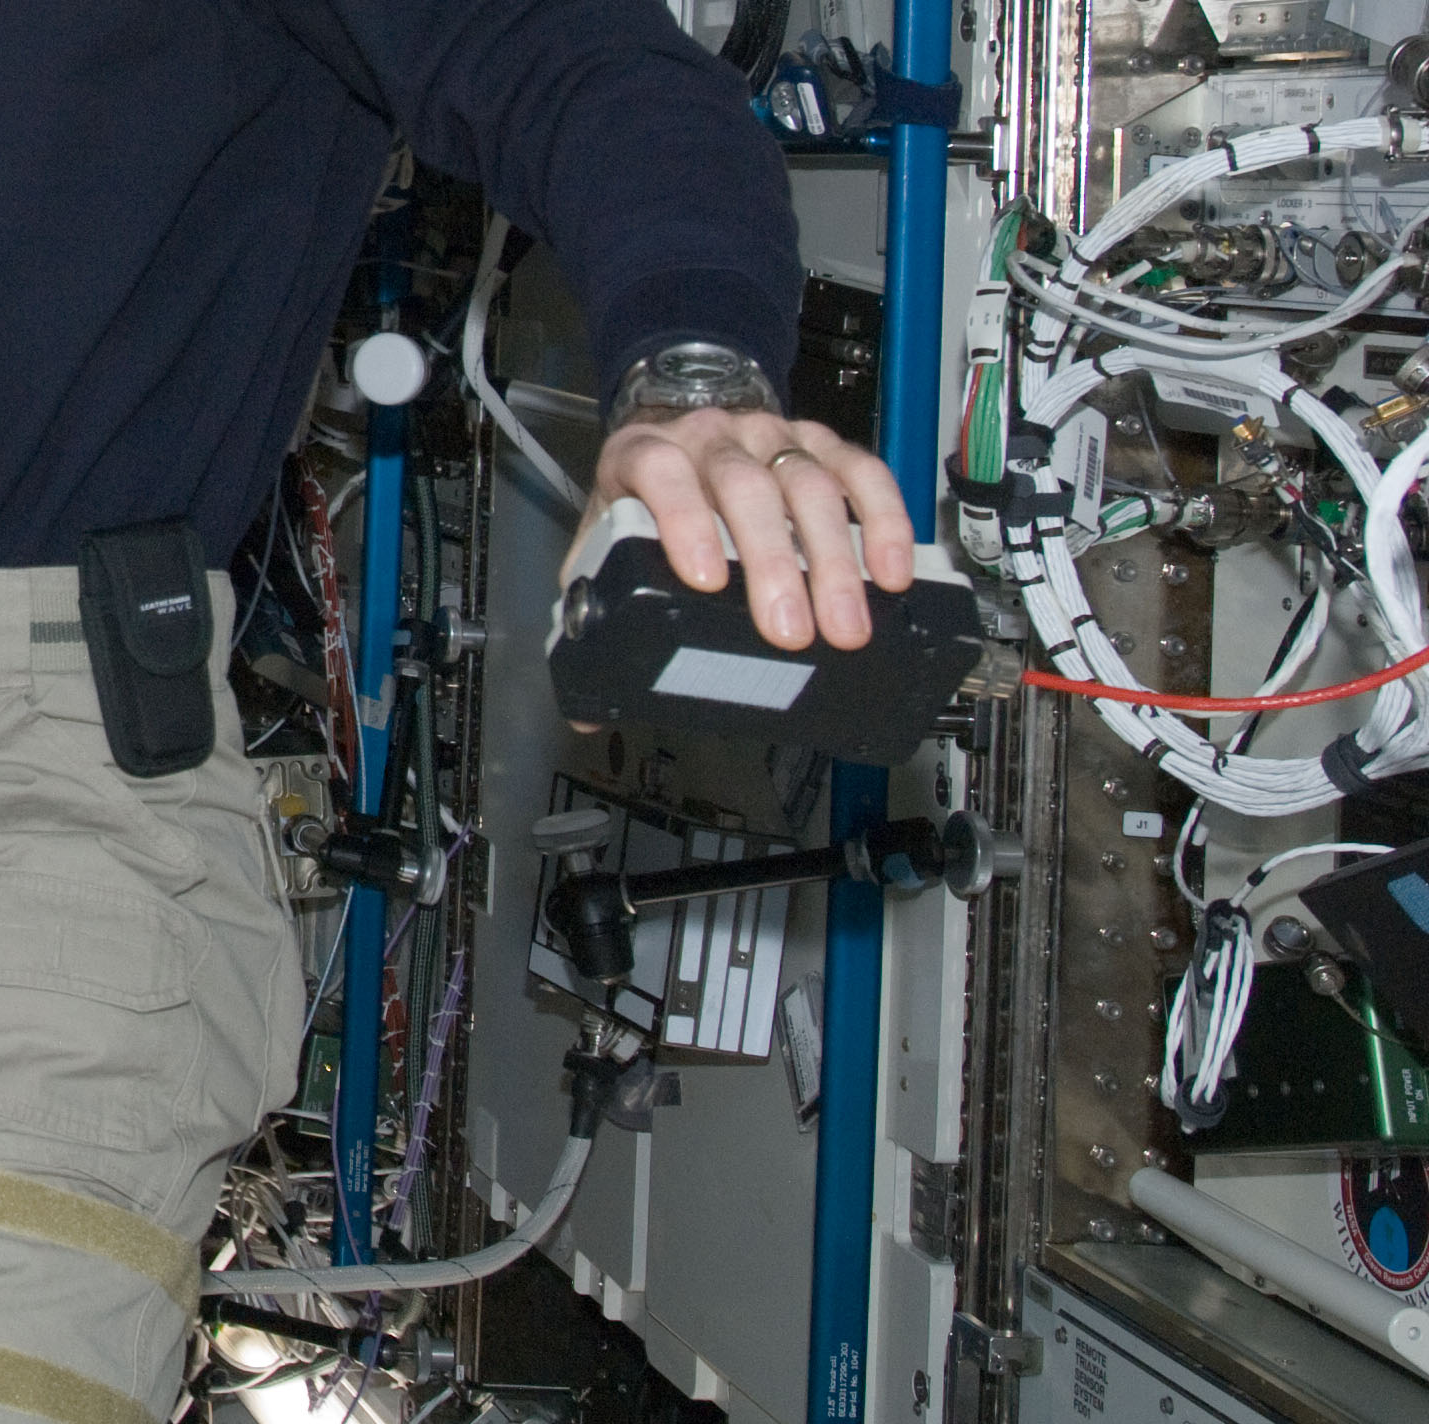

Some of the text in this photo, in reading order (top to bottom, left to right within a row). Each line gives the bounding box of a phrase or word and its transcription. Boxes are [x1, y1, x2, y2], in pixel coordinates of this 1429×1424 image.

[157, 601, 192, 615] WAVE
[1402, 1068, 1418, 1123] INPUT POWER
[1382, 1270, 1415, 1287] Research
[1075, 1337, 1108, 1369] REMOTE
[1075, 1352, 1109, 1385] TRIAXIAL
[829, 1355, 837, 1393] Handrail
[850, 1374, 859, 1388] No.
[1074, 1367, 1105, 1399] SENSOR
[849, 1391, 858, 1418] Serial
[1073, 1382, 1104, 1414] SYSTEM
